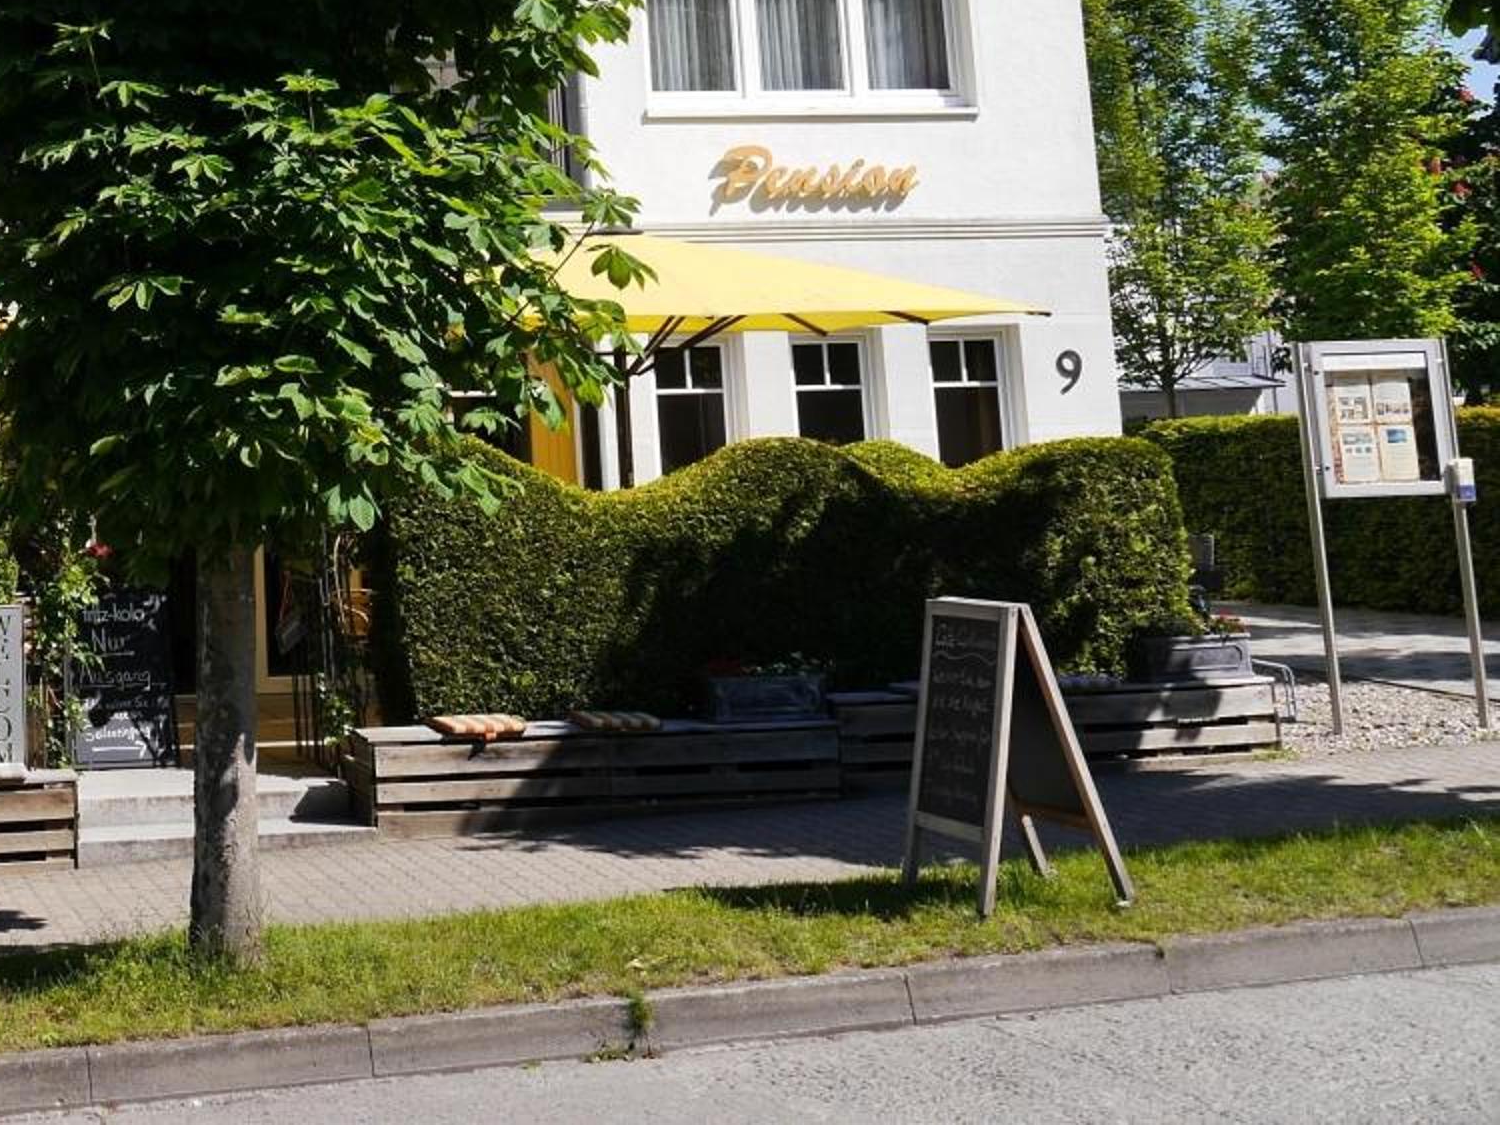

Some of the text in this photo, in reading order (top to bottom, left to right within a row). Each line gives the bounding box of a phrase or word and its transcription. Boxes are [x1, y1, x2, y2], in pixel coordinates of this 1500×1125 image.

[716, 144, 920, 205] Pension
[1055, 349, 1083, 395] 9
[92, 627, 131, 652] Nur
